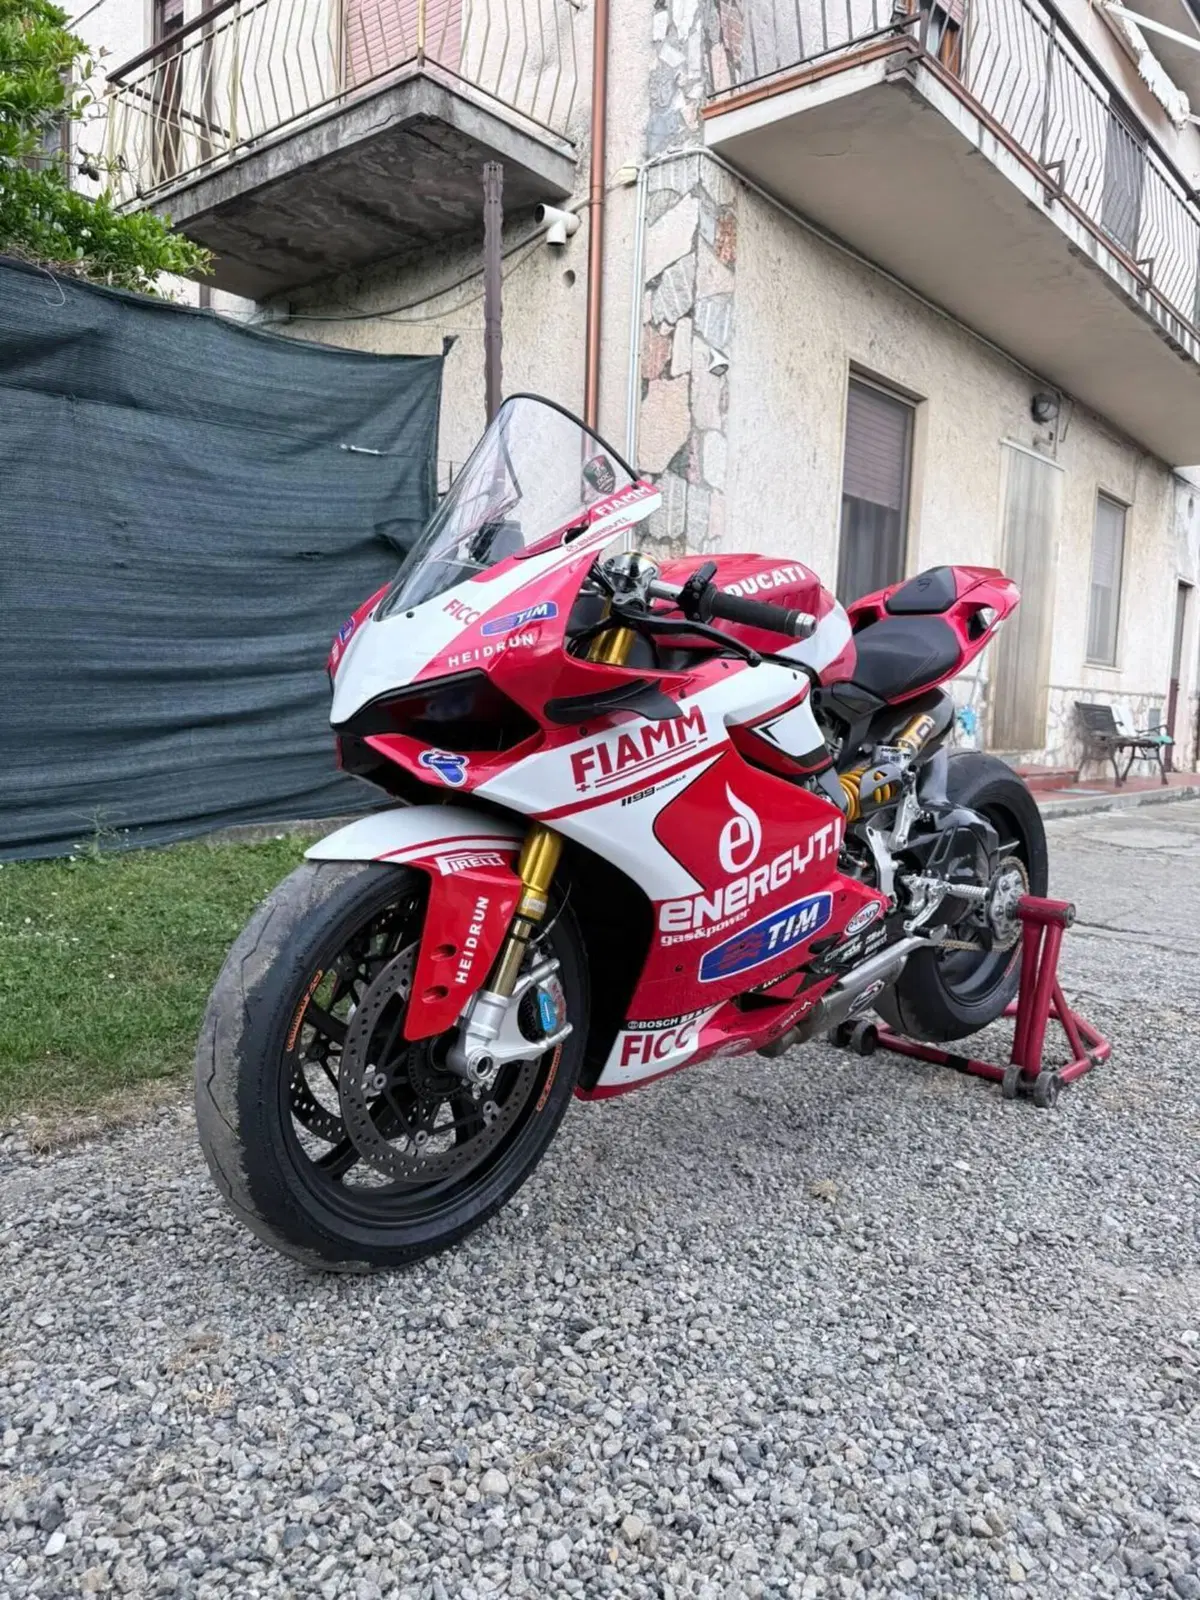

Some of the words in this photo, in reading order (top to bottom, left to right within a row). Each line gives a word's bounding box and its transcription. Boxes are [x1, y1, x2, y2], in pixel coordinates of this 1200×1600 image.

[596, 485, 653, 516] FIAMM
[722, 566, 806, 597] DUCATI
[442, 599, 481, 625] FICC
[516, 604, 548, 624] TIM
[448, 633, 535, 667] HEIDRUN
[570, 705, 707, 785] FIAMM
[621, 786, 655, 807] 1199
[434, 852, 506, 876] PIRELLI
[455, 896, 490, 984] HEIDRUN
[661, 908, 750, 947] gas&power
[768, 902, 820, 950] TIM
[638, 1017, 679, 1029] BOSCH
[620, 1020, 698, 1068] FICC
